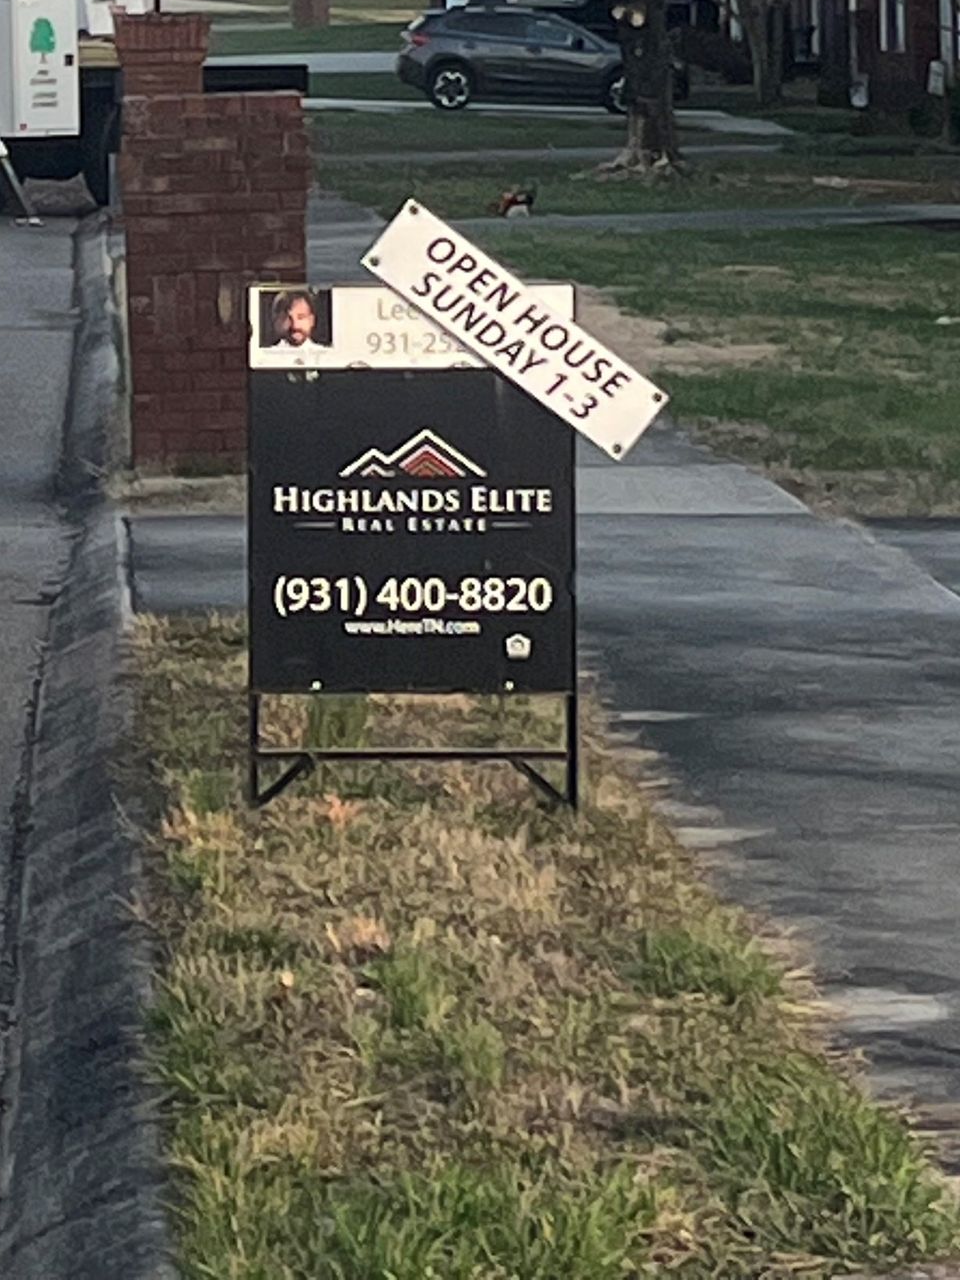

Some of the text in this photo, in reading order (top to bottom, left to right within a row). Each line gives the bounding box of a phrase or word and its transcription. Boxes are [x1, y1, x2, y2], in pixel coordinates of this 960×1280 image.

[426, 237, 632, 399] OPEN HOUSE
[410, 271, 600, 420] SUNDAY 1-3
[273, 486, 553, 513] HIGHLANDS ELITE
[341, 517, 487, 532] REAL ESTATE
[274, 575, 553, 617] (931) 400-8820
